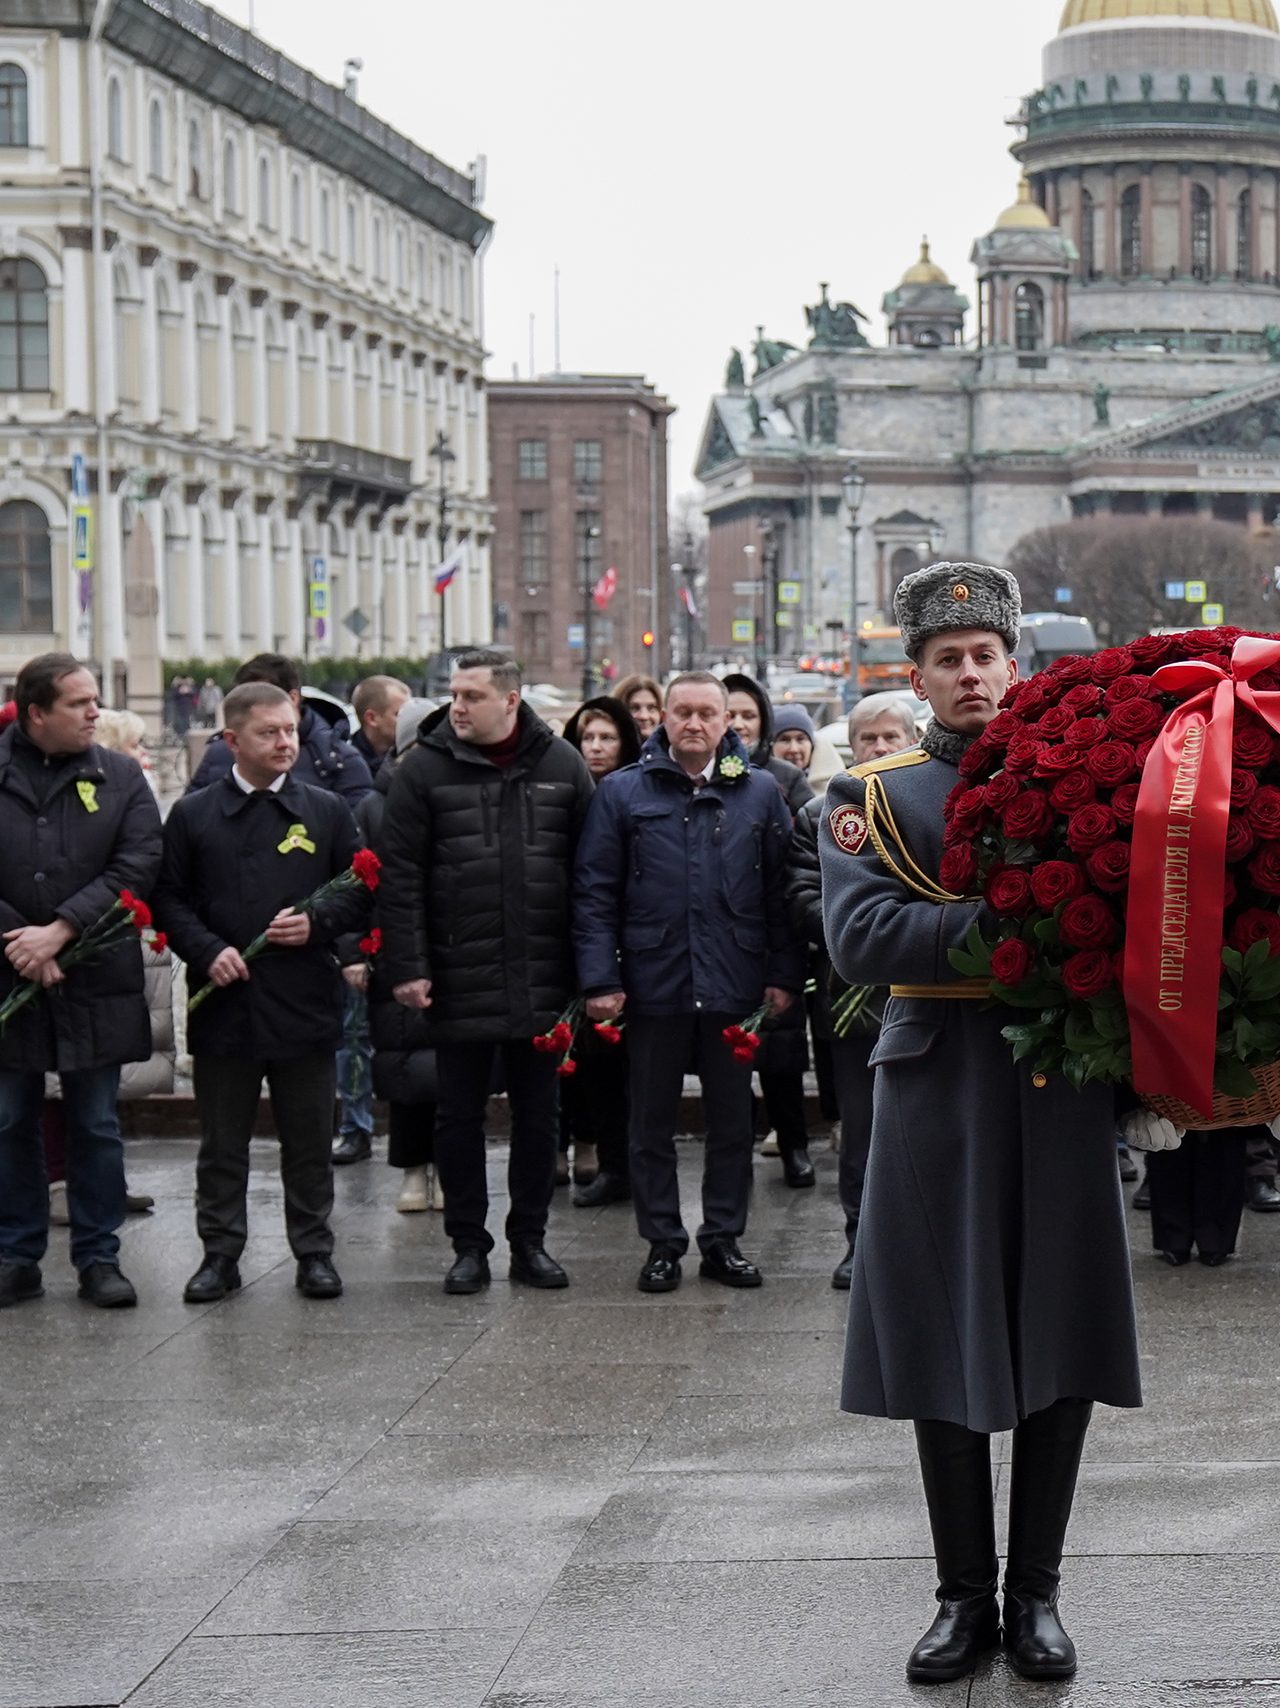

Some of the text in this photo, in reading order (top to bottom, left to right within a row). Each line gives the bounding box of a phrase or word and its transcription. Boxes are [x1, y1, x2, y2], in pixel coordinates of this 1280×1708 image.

[1166, 823, 1192, 839] И
[1160, 846, 1191, 982] ПРЕДСЕДАТЕЛЯ
[1158, 988, 1183, 1012] ОТ
